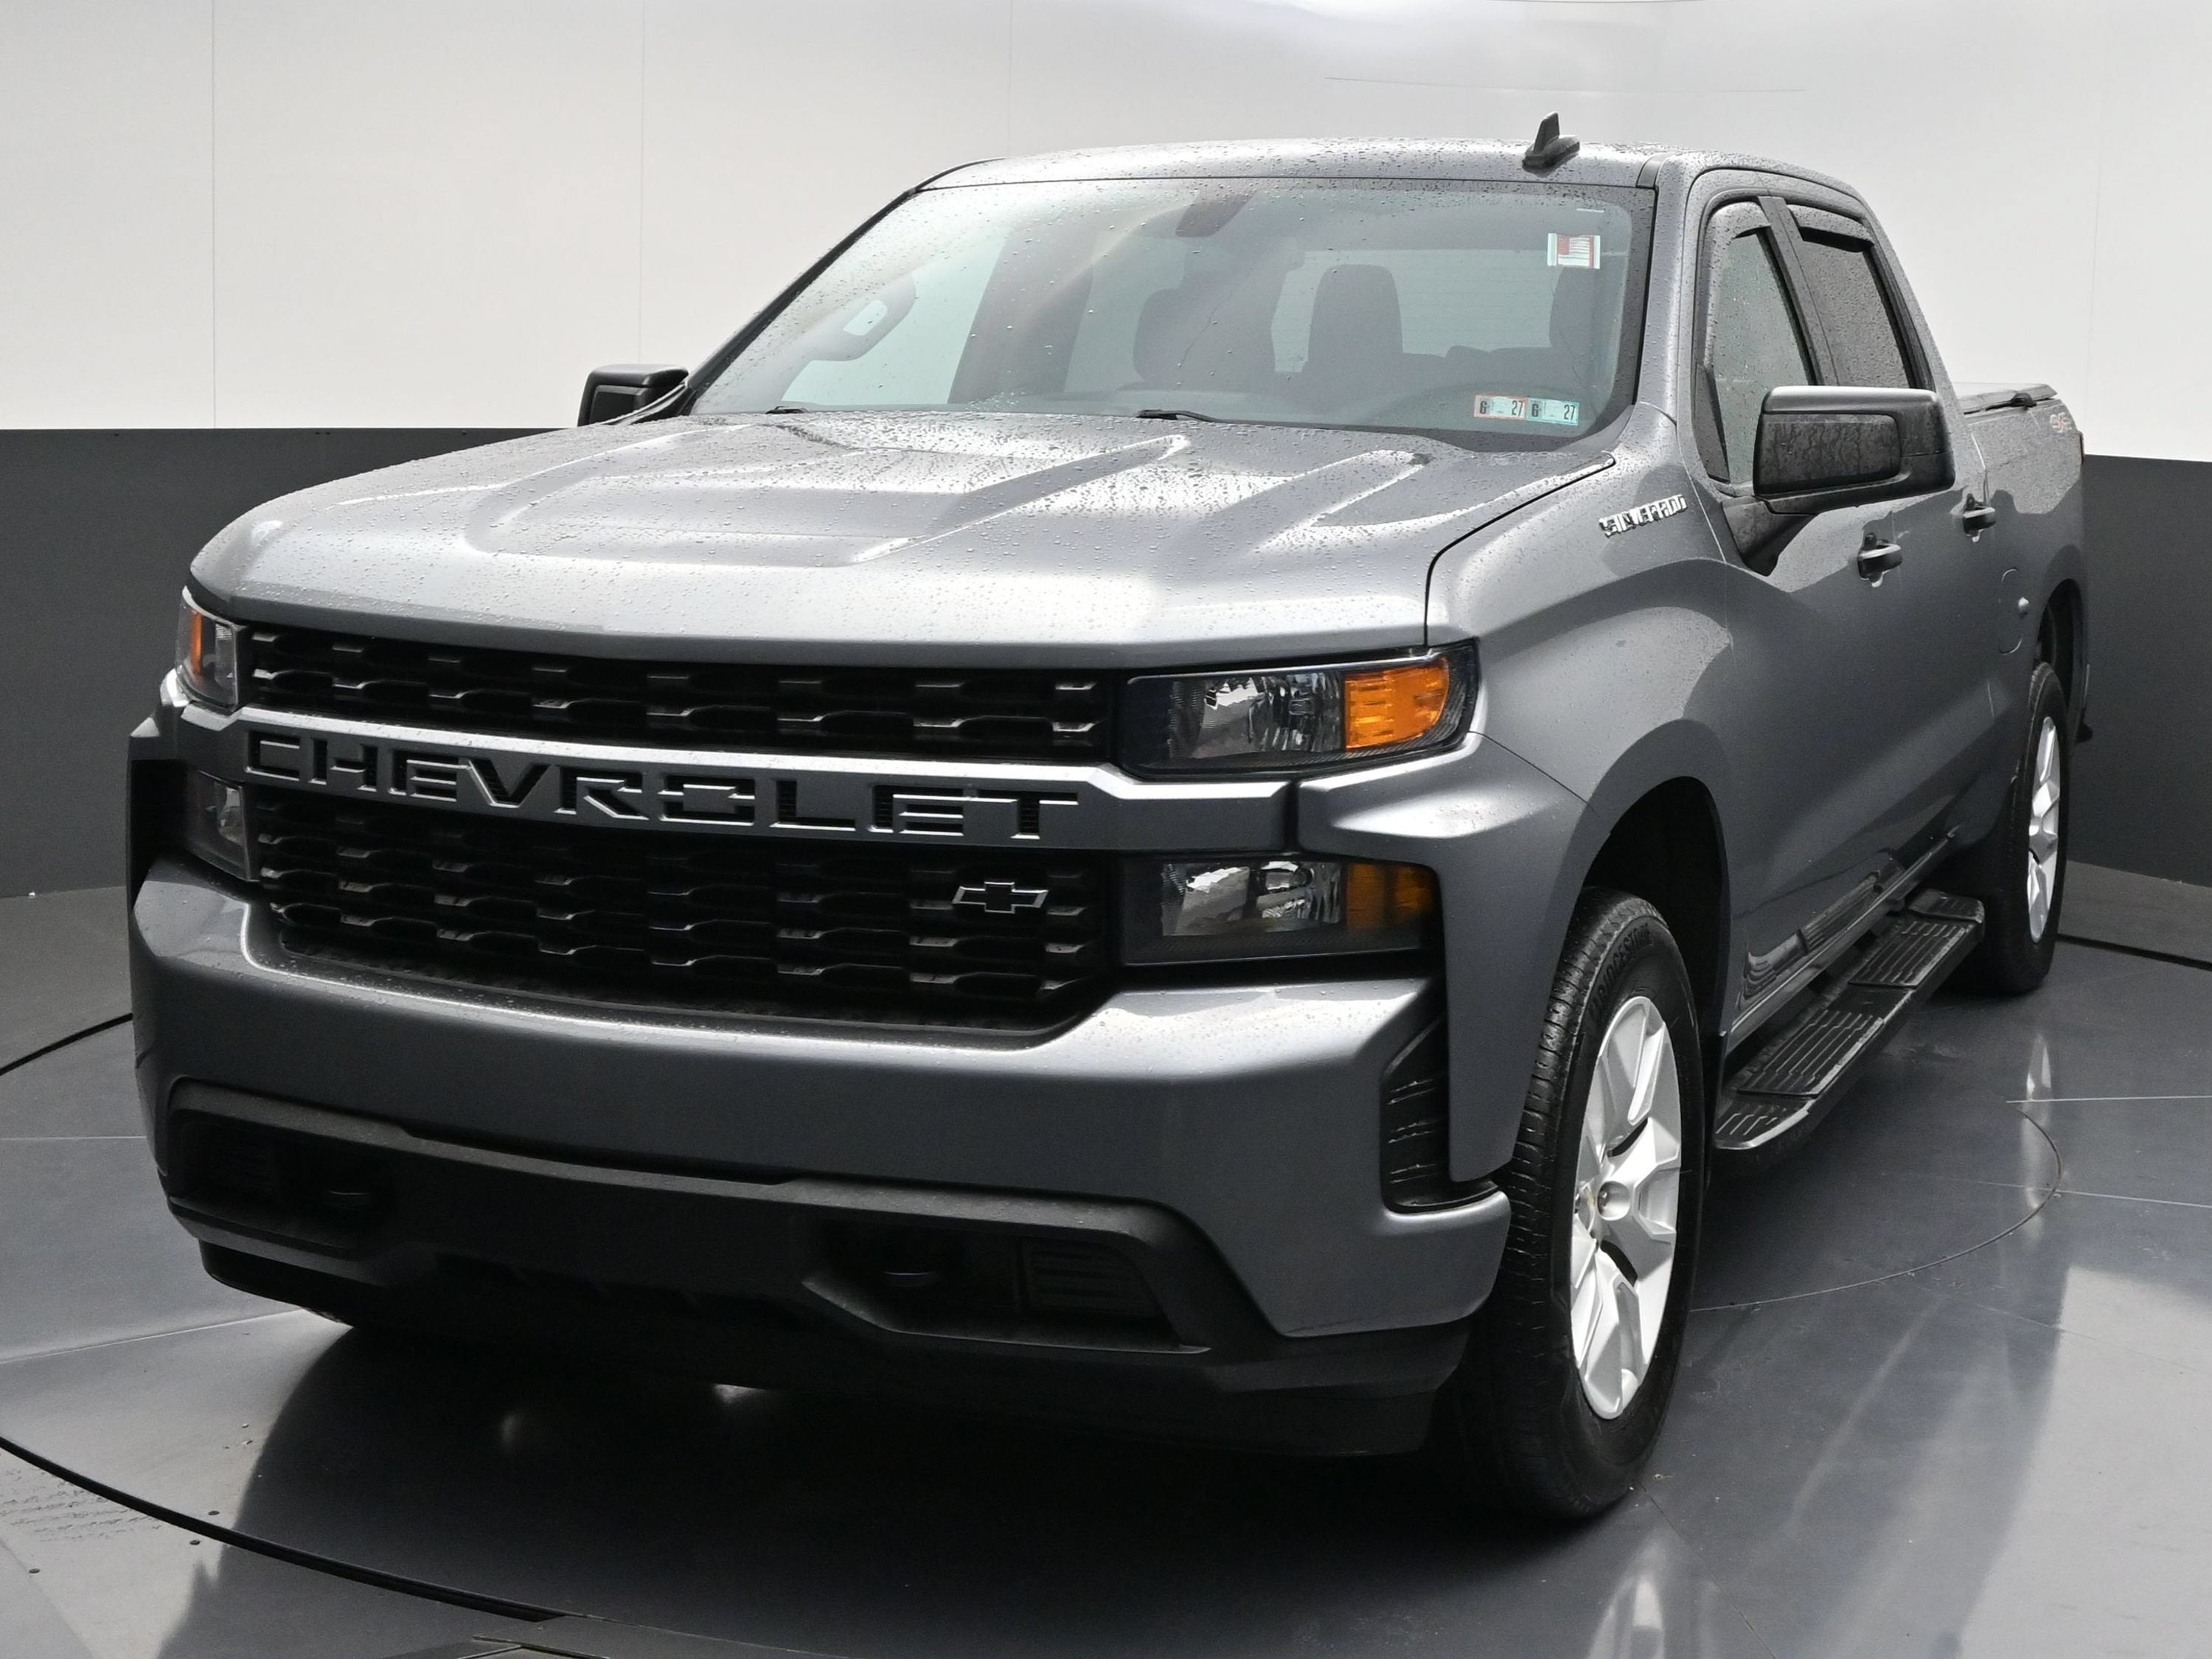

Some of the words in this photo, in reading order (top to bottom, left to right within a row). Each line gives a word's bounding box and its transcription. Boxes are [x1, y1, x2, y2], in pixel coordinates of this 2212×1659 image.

[1479, 400, 1487, 414] 6
[1512, 400, 1523, 417] 27
[1531, 403, 1540, 417] 6
[1563, 404, 1575, 420] 27
[245, 730, 1079, 841] CHEVROLET
